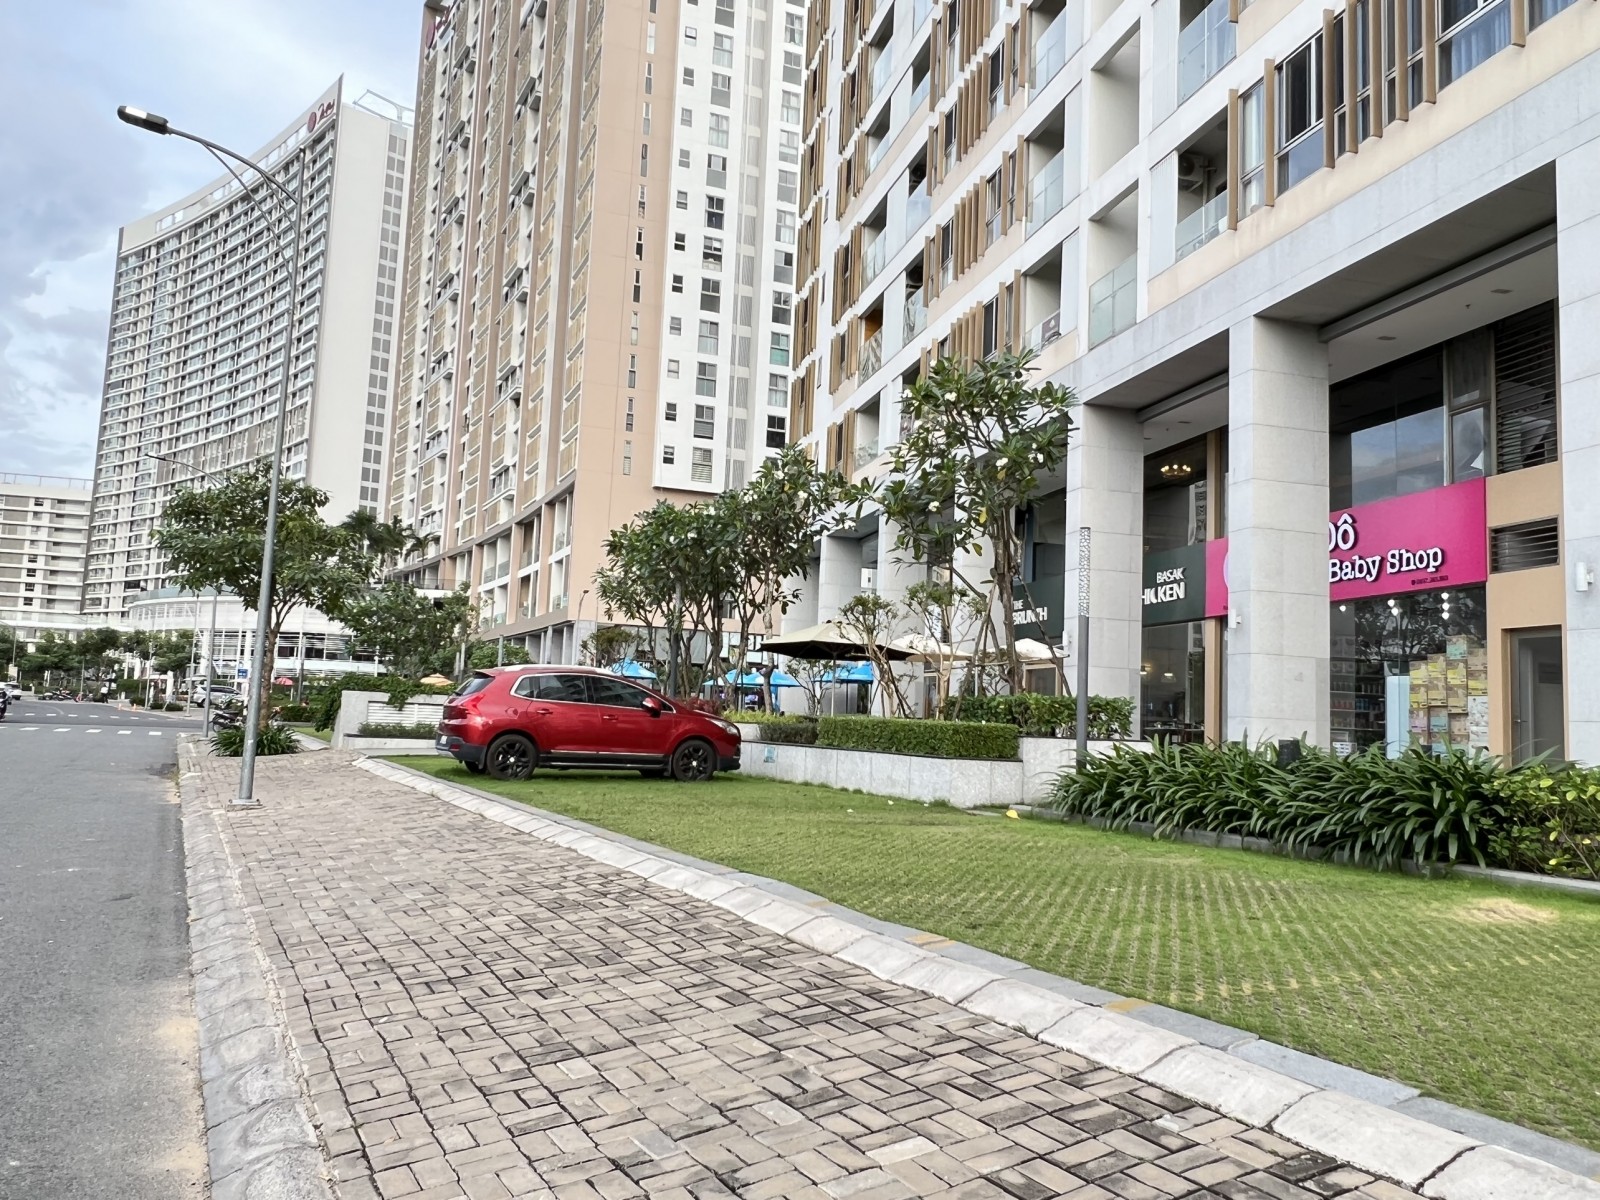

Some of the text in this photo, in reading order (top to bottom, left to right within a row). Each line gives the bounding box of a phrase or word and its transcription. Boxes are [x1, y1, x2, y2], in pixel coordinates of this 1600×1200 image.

[1329, 555, 1381, 583] Baby
[1386, 547, 1443, 574] Shop
[1156, 567, 1186, 584] BASAK
[1012, 606, 1048, 626] BRUNH
